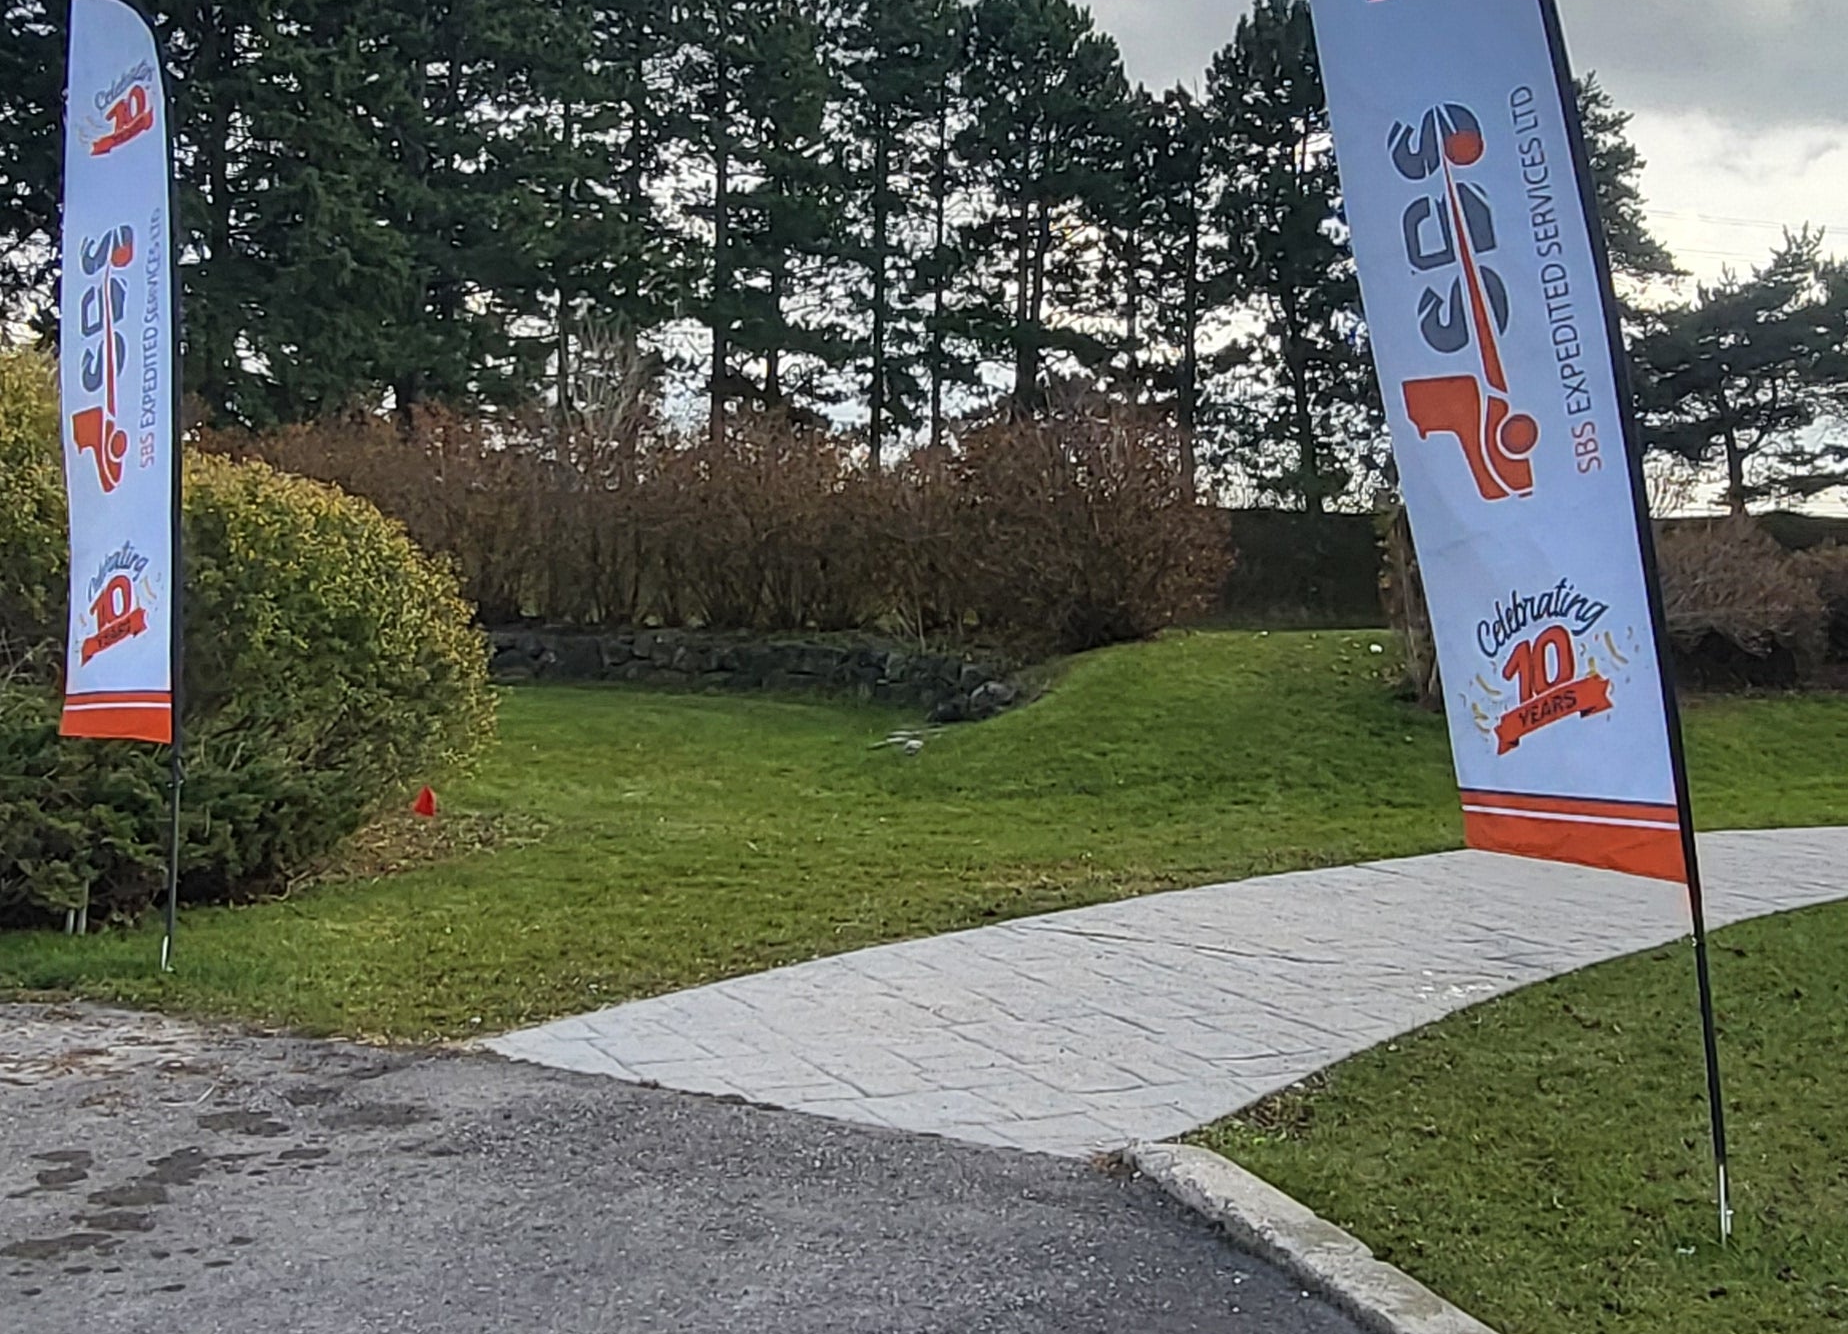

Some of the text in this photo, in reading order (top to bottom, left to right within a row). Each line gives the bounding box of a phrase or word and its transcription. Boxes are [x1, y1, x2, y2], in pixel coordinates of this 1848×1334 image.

[105, 84, 147, 134] 10
[1510, 85, 1602, 474] SBS EXPEDITED SERVICES LTD
[140, 327, 159, 429] EXPEDITED
[139, 431, 156, 469] SBS
[89, 574, 132, 634] 10
[1476, 577, 1610, 659] Celebrating
[1502, 624, 1575, 705] 10
[1517, 690, 1578, 729] YEARS
